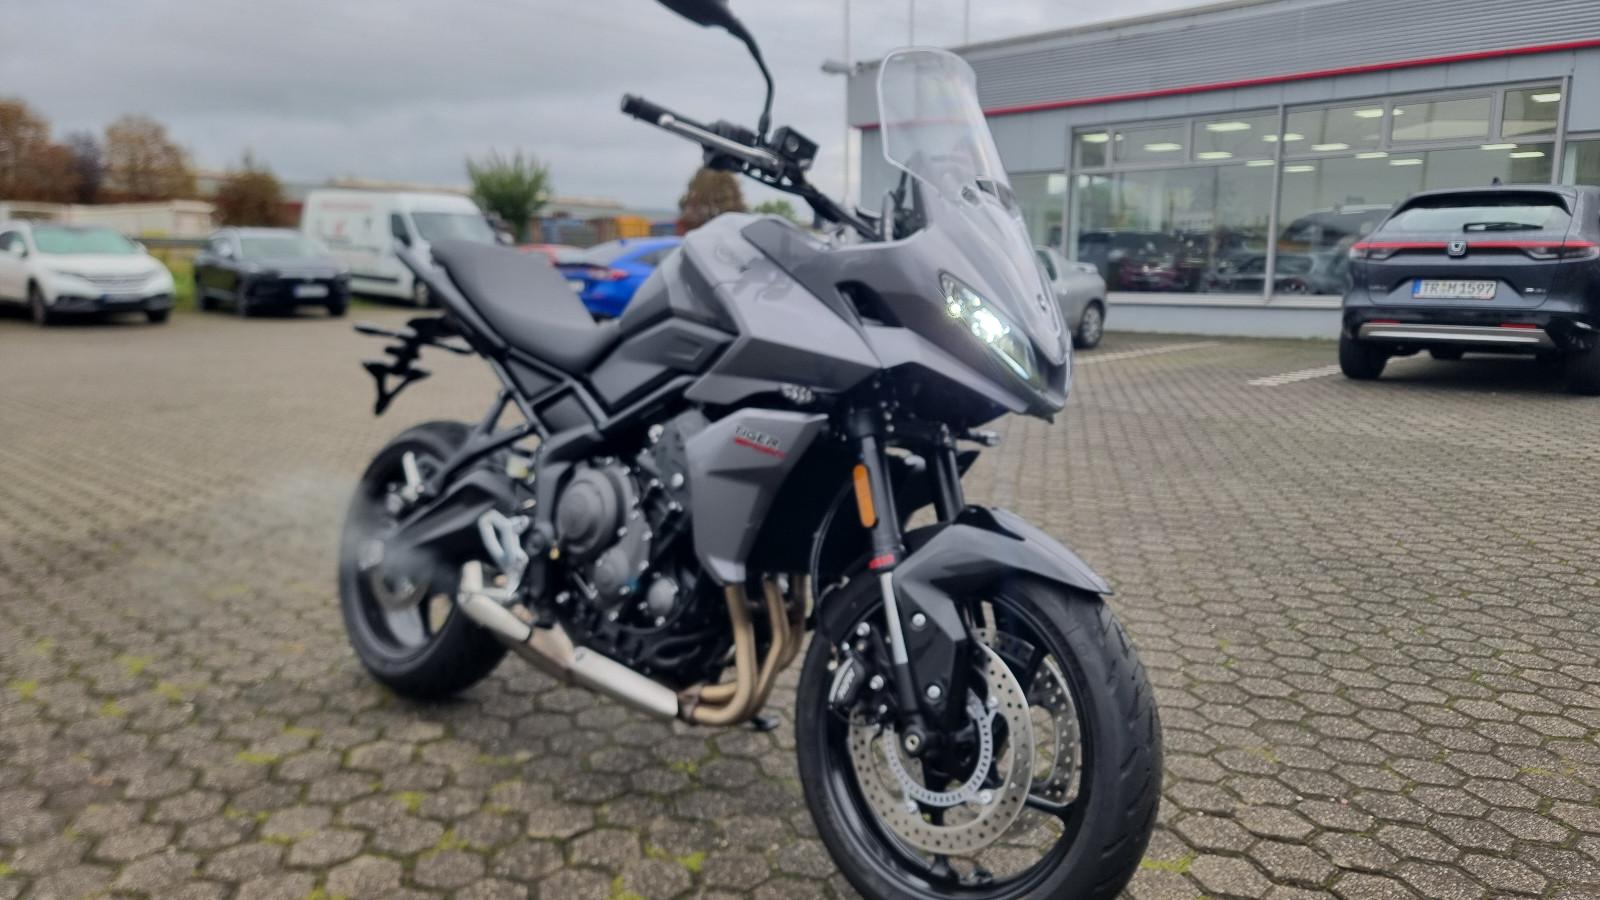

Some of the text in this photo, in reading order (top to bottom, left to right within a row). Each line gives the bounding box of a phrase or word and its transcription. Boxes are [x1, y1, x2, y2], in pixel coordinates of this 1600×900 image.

[1423, 282, 1440, 294] TR
[1459, 282, 1494, 295] 1597
[735, 425, 779, 447] TIGER
